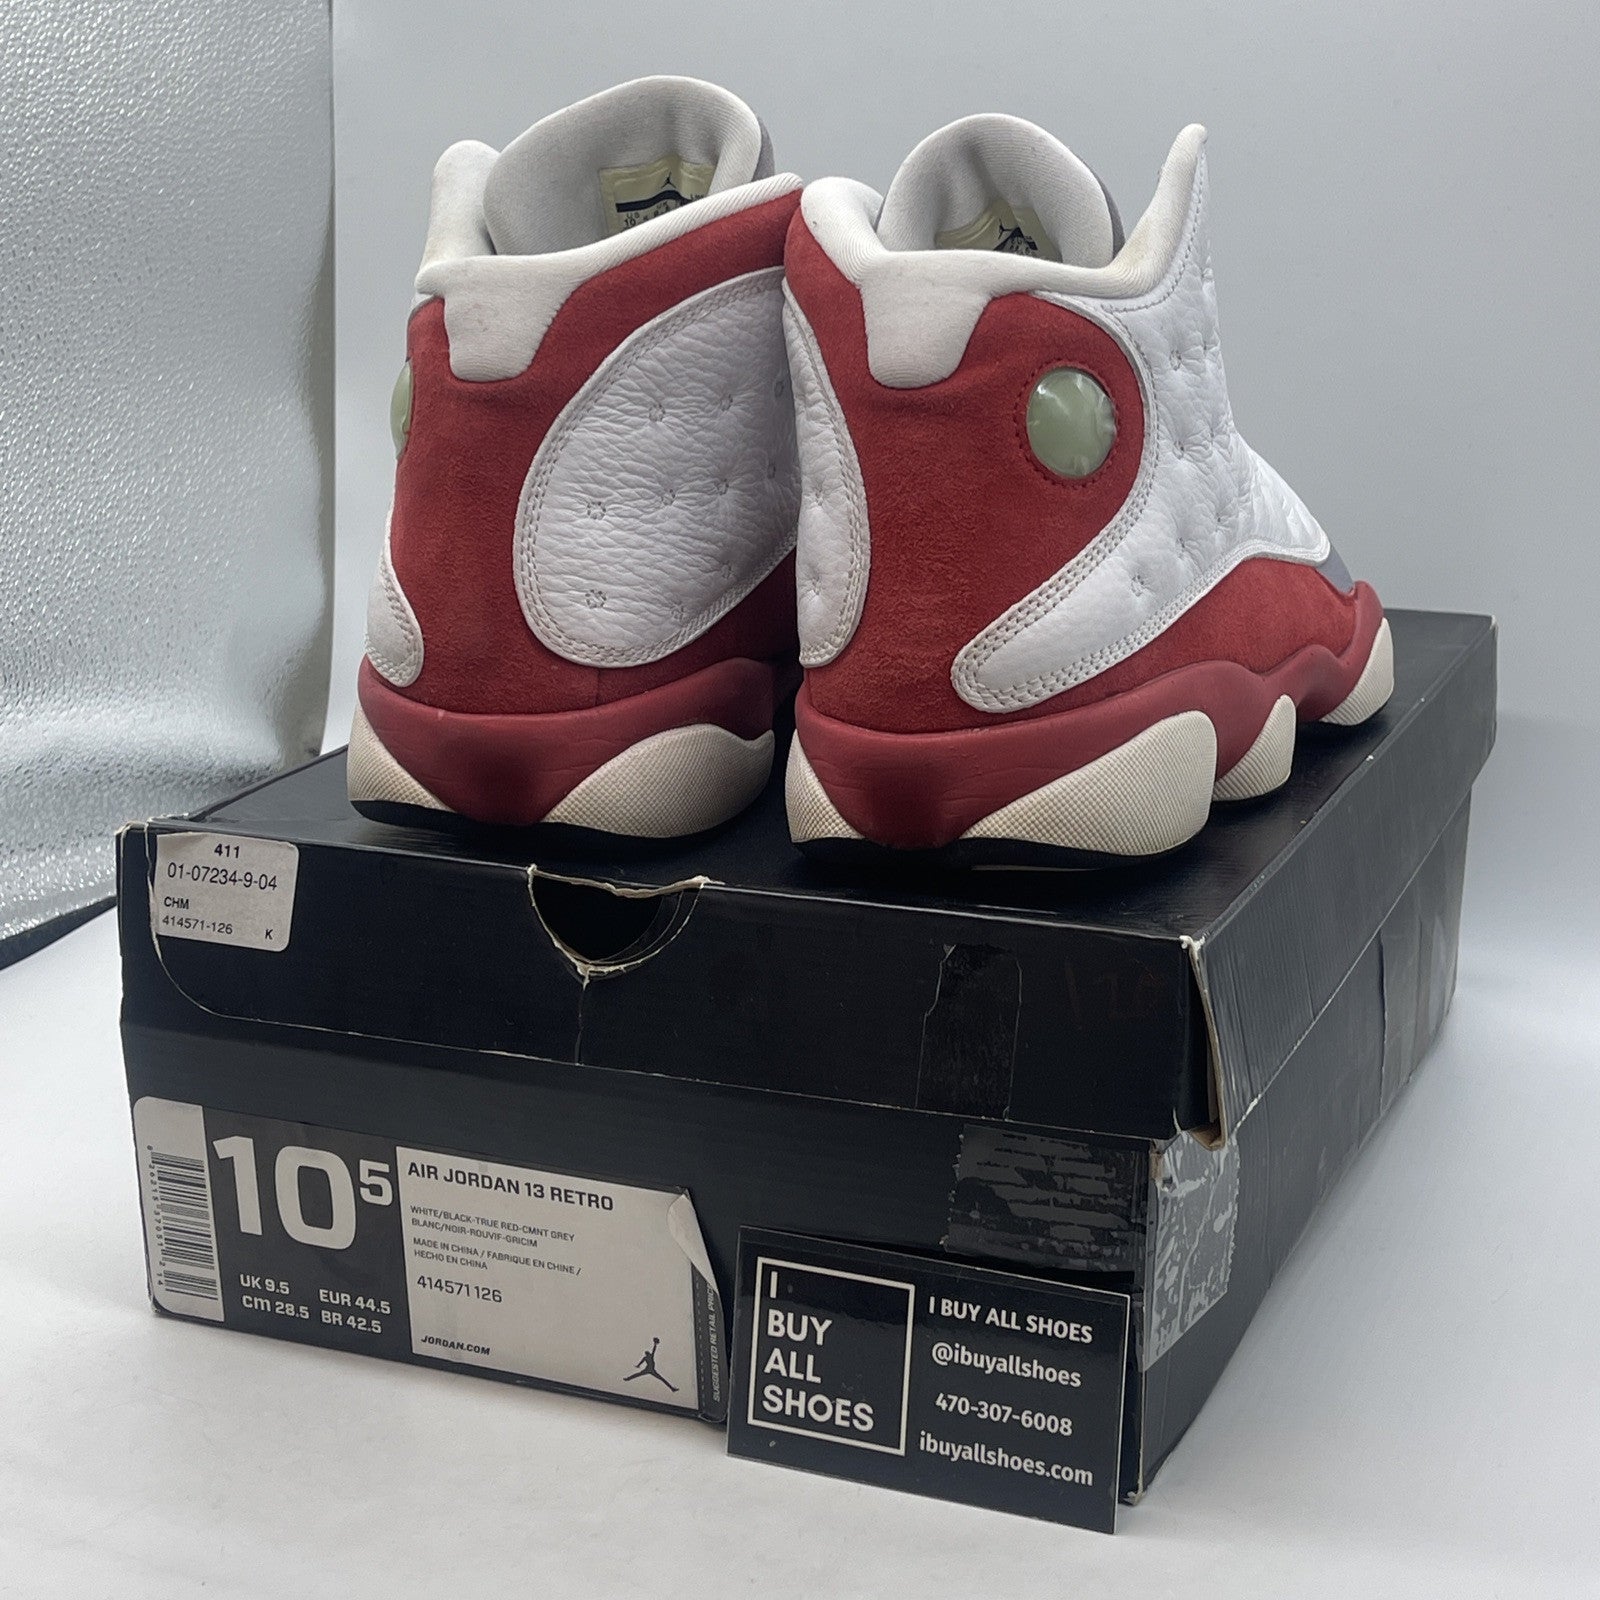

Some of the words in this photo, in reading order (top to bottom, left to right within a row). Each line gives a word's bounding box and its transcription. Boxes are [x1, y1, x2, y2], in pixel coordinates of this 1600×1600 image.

[213, 843, 241, 859] 411
[167, 862, 278, 891] 01-07234-9-04
[164, 896, 190, 910] CHM
[162, 915, 233, 935] 414571-126
[264, 928, 274, 940] K
[408, 1162, 439, 1181] AIR
[443, 1168, 520, 1195] JORDAN
[524, 1182, 545, 1199] 13
[550, 1186, 614, 1211] RETRO
[410, 1205, 498, 1228] WHITE/BLACK-TRUE
[500, 1221, 549, 1239] RED-CMNT
[550, 1230, 575, 1243] GREY
[411, 1217, 538, 1248] BLANC/NOIR-ROUVIF-GRICIM
[413, 1237, 439, 1249] MADE
[440, 1241, 450, 1251] IN
[451, 1244, 479, 1257] CHINA
[486, 1251, 531, 1267] FABRIQUE
[532, 1258, 546, 1269] EN
[546, 1261, 575, 1274] CHINE
[575, 1267, 582, 1276] /
[414, 1249, 445, 1262] HECHO
[446, 1255, 459, 1265] EN
[459, 1257, 488, 1270] CHINA
[239, 1273, 263, 1290] UK
[264, 1277, 290, 1295] 9.5
[768, 1270, 778, 1299] I
[275, 1301, 310, 1319] 28.5
[318, 1289, 352, 1307] EUR
[354, 1296, 391, 1315] 44.5
[321, 1309, 343, 1327] BR
[346, 1315, 382, 1334] 42.5
[767, 1308, 833, 1346] BUY
[929, 1296, 936, 1314] I
[940, 1299, 982, 1323] BUY
[985, 1307, 1021, 1331] ALL
[1025, 1315, 1093, 1344] SHOES
[420, 1334, 491, 1356] JORDAN.COM
[763, 1347, 822, 1384] ALL
[931, 1341, 1082, 1388] @ibuyallshoes
[761, 1384, 874, 1432] SHOES
[935, 1392, 1073, 1437] 470-307-6008
[919, 1430, 1094, 1486] ibuyallshoes.com
